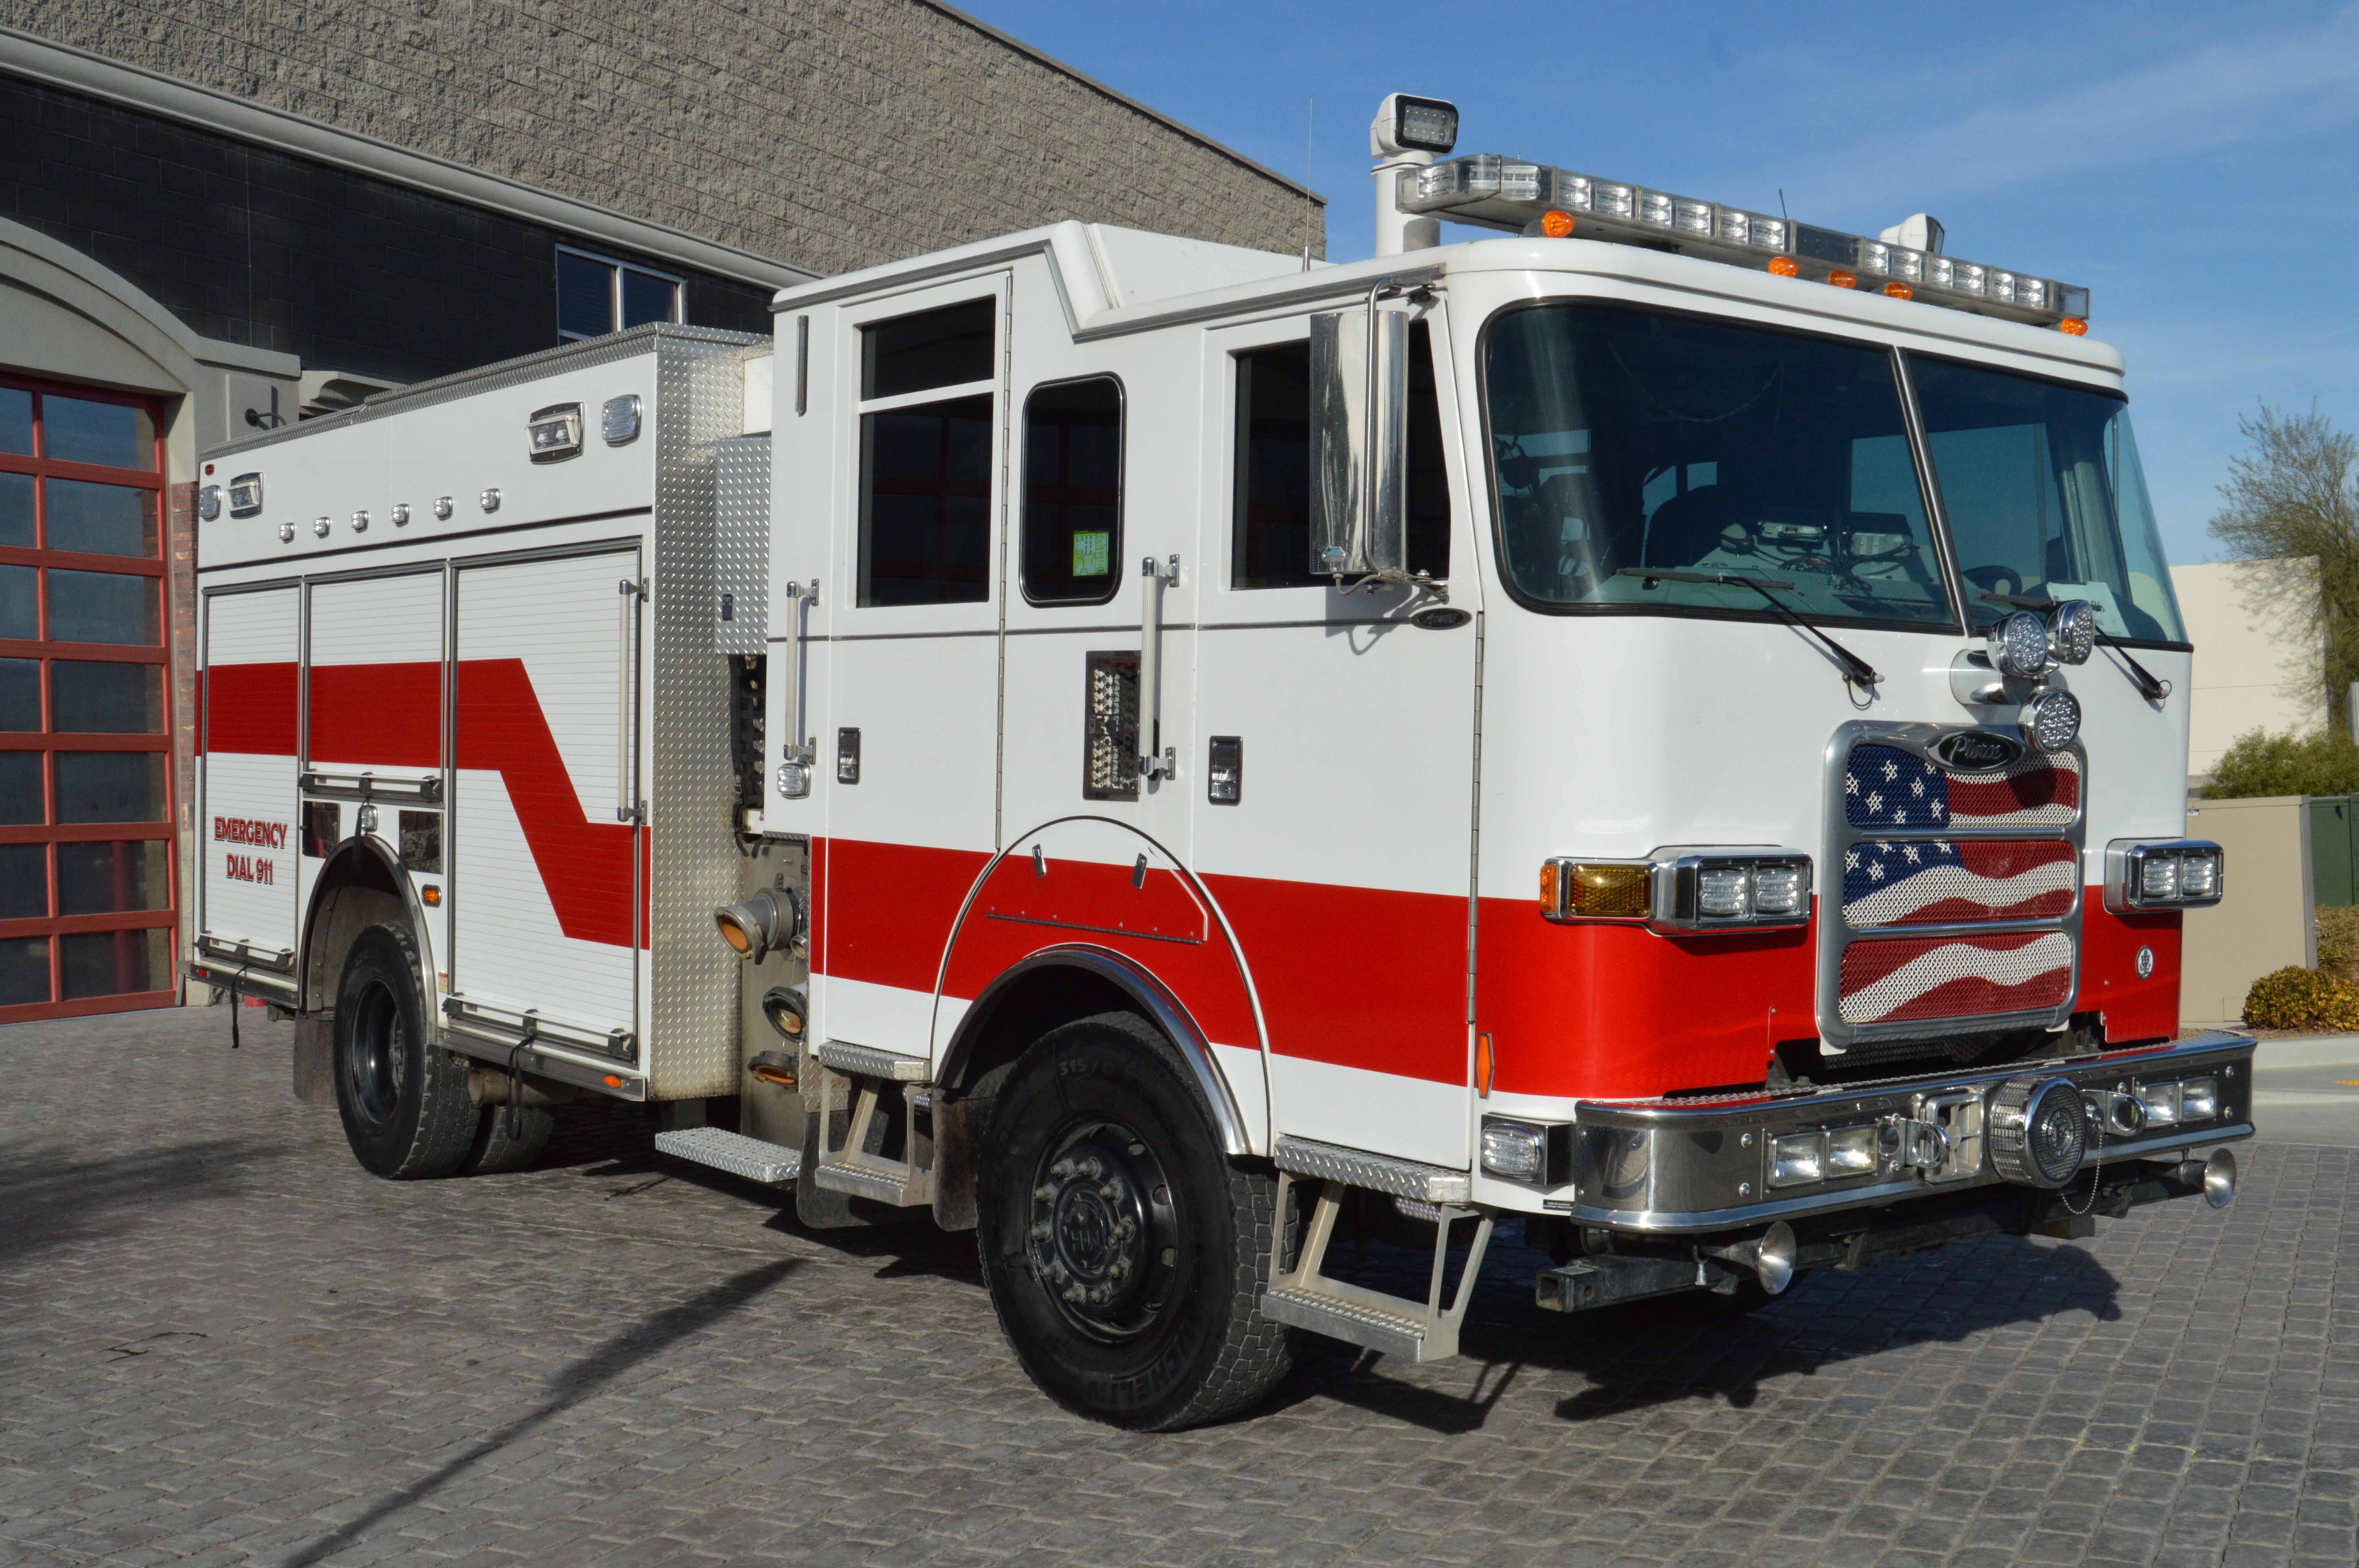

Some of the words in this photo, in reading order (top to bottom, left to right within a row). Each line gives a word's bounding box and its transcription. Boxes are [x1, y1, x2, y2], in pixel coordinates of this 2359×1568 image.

[1949, 735, 2001, 762] Pierce
[214, 816, 288, 849] EMERGENCY
[226, 853, 254, 882] DIAL
[256, 857, 274, 885] 911
[1058, 1058, 1088, 1076] 315
